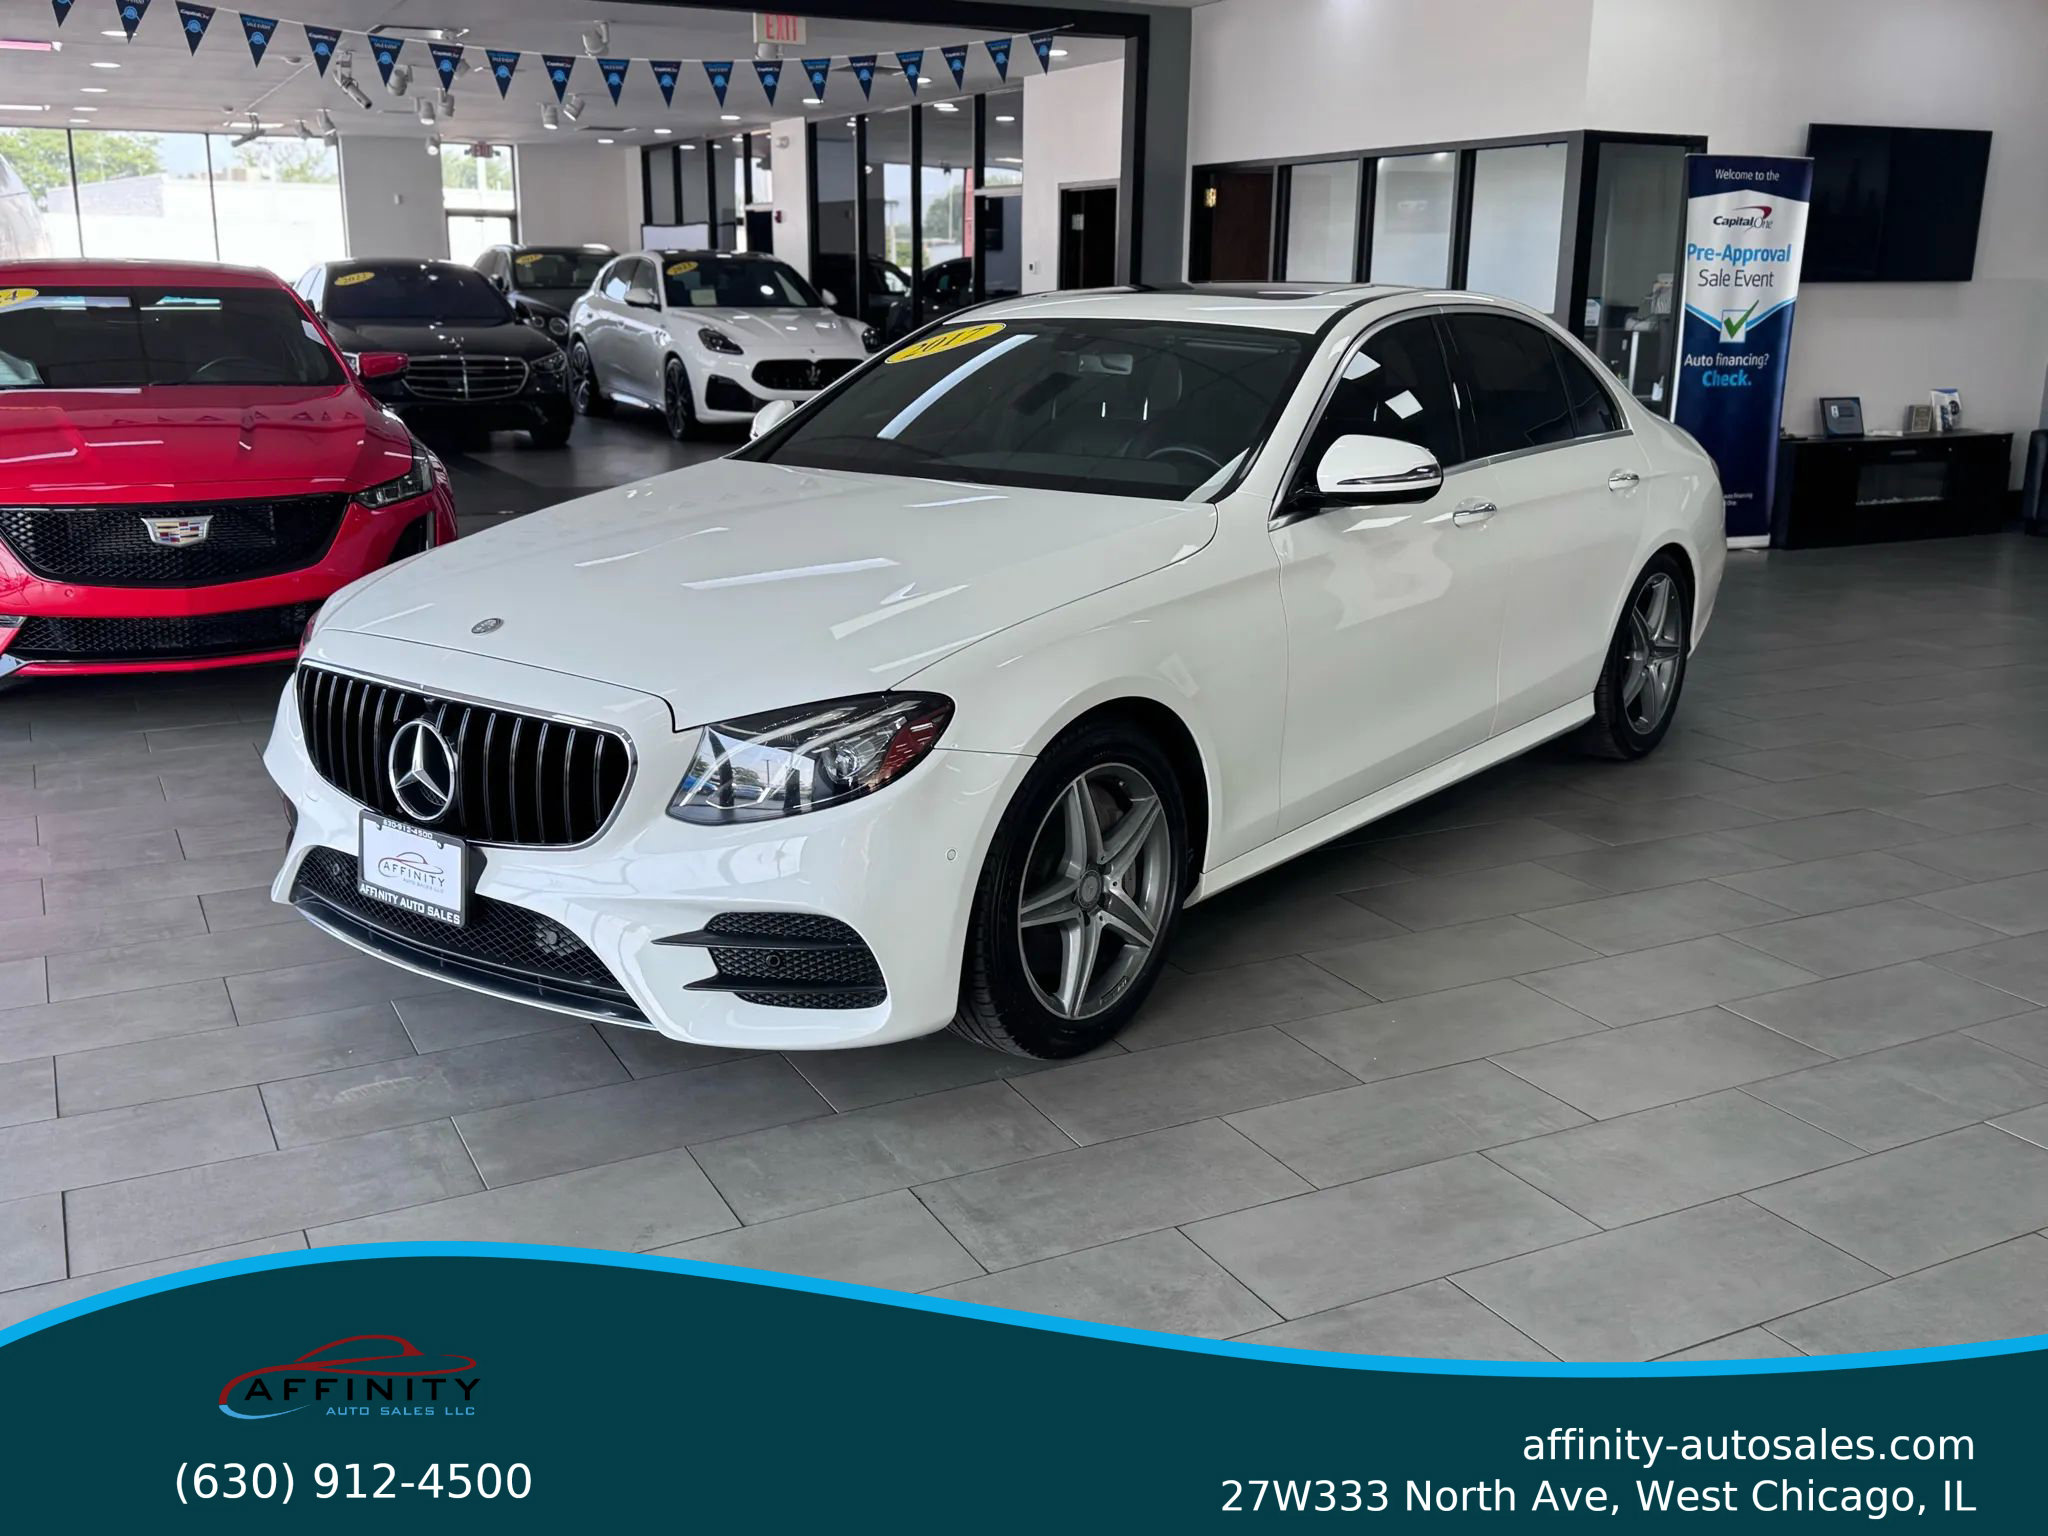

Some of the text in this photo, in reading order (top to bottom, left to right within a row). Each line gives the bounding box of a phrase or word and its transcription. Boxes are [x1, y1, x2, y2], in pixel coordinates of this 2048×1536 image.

[766, 14, 798, 41] EXIT
[1715, 169, 1780, 181] Welcome to the
[1687, 243, 1792, 267] Pre-Approval
[1698, 268, 1775, 288] Sale Event
[899, 325, 988, 360] 2017
[1684, 353, 1770, 370] Auto financing?
[1702, 369, 1752, 387] Check.
[383, 861, 445, 887] AFFINITY
[360, 883, 460, 925] AFFINITY AUTO SALES
